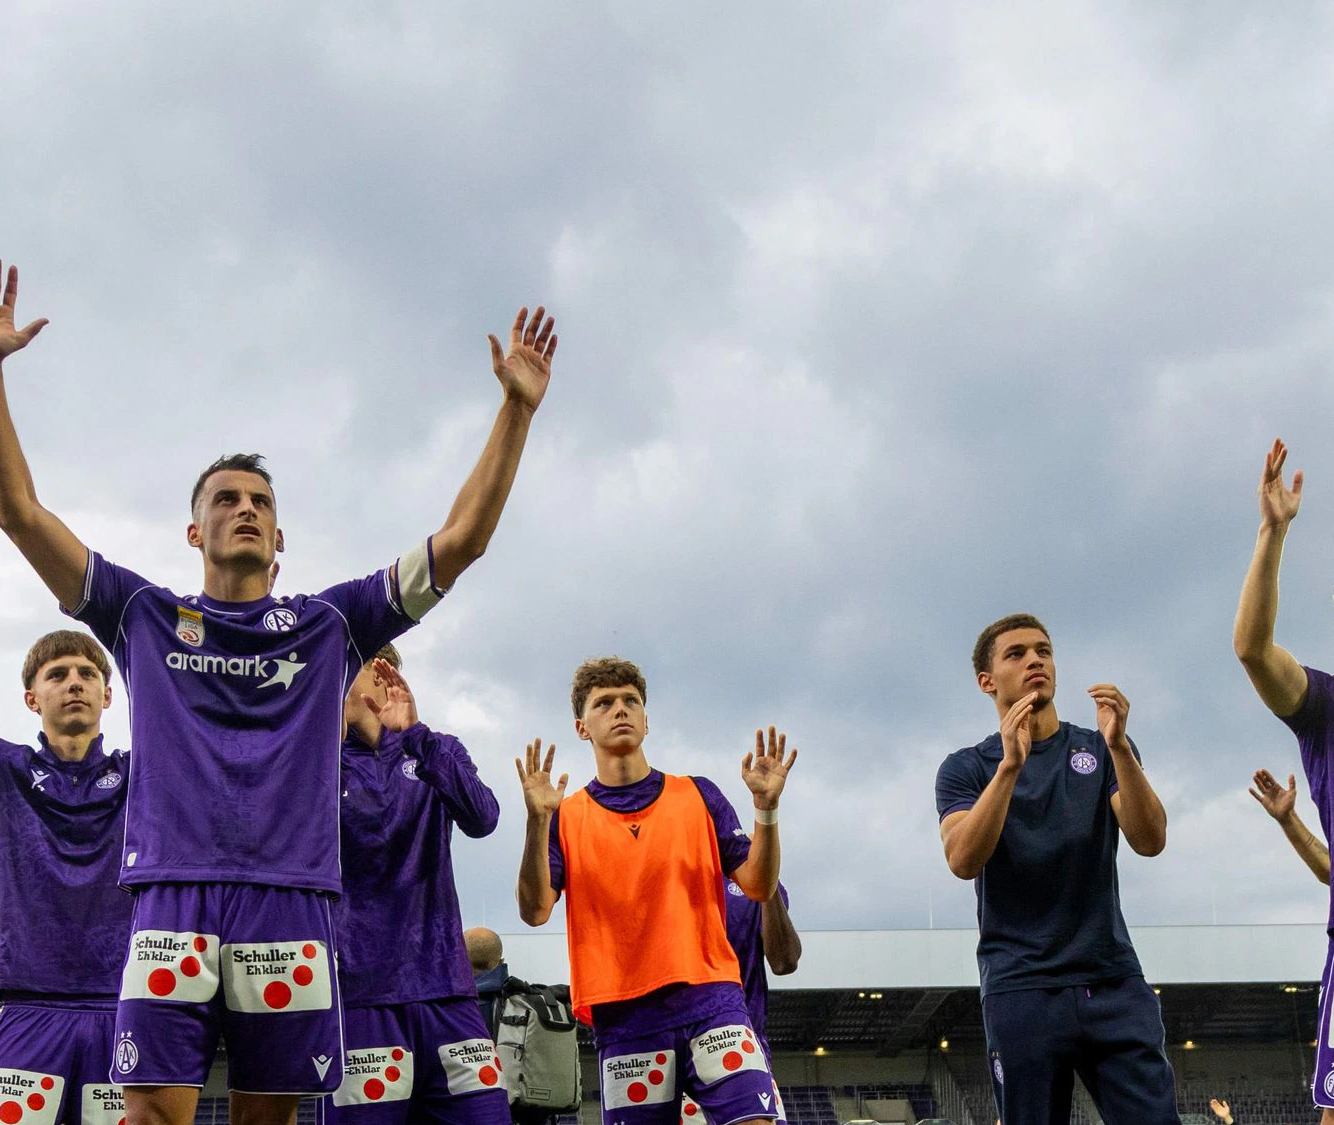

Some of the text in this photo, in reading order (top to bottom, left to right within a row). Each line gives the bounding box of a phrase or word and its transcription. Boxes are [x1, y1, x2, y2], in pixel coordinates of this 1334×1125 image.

[166, 652, 269, 678] aramark
[137, 951, 177, 963] Eh'klar
[233, 949, 297, 964] Schuller
[246, 964, 287, 975] Eh'klar
[698, 1030, 742, 1048] Schuller
[448, 1043, 493, 1058] Schuller
[347, 1053, 387, 1066] chuller
[607, 1058, 651, 1073] Schuller
[614, 1070, 644, 1080] Eh'klar
[92, 1089, 124, 1100] Schu
[103, 1102, 125, 1111] Eh'k
